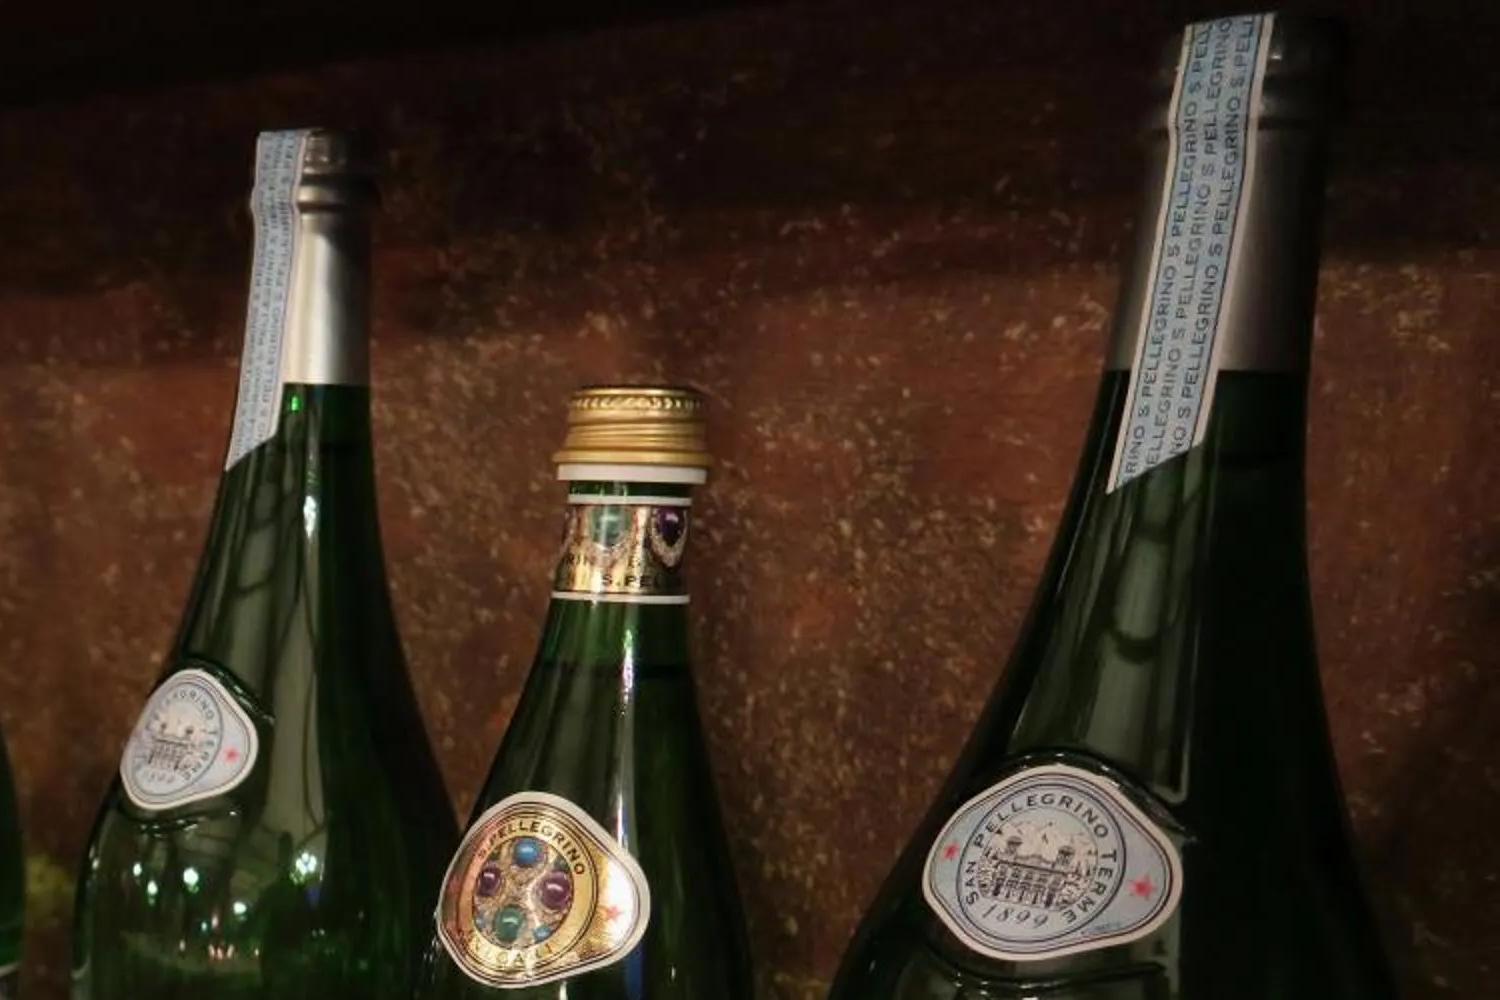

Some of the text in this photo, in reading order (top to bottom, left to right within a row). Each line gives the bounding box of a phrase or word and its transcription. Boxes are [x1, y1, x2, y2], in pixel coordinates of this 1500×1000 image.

[1142, 265, 1177, 398] PELLEGRINO
[1171, 101, 1198, 237] PELLEGRINO
[1175, 183, 1211, 320] PELLEGRINO
[1204, 18, 1233, 155] PELLEGRINO
[1181, 264, 1219, 399] PELLEGRINO
[1212, 96, 1242, 235] PELLEGRINO
[964, 793, 1118, 924] SAN PELLEGRINO TERME
[982, 904, 1049, 928] 1899
